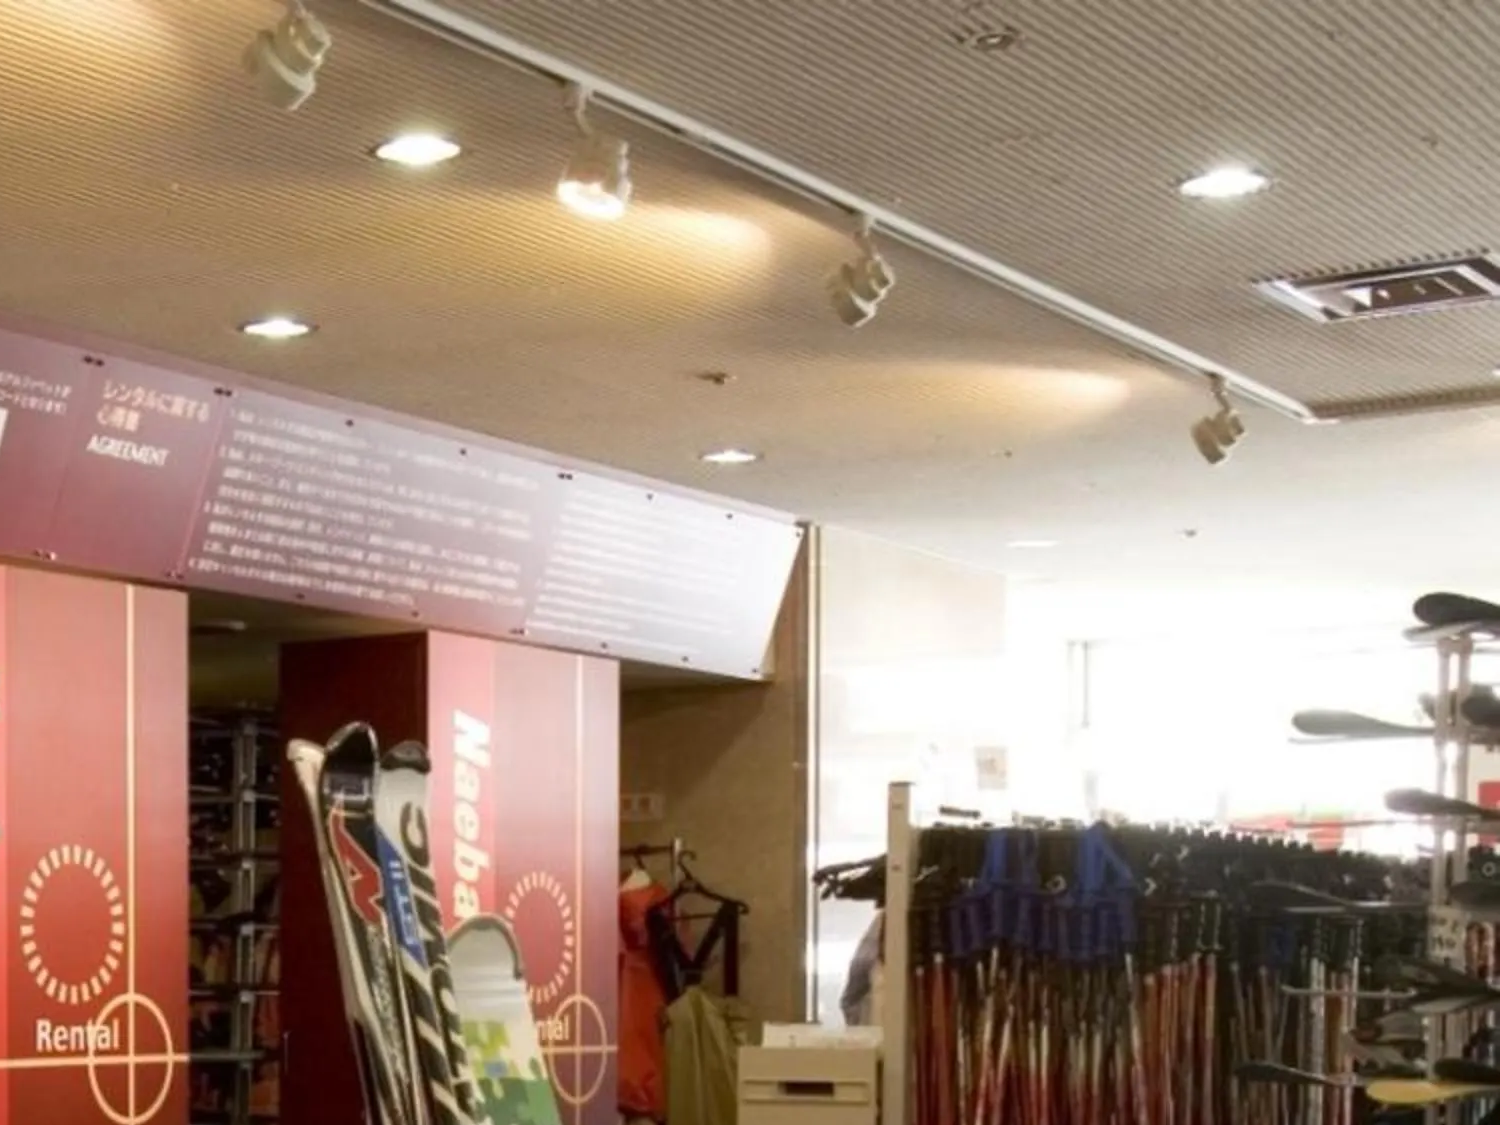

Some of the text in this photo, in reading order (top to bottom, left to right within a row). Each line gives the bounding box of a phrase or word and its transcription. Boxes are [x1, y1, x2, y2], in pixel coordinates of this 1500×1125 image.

[453, 709, 494, 919] Naeba
[36, 1018, 120, 1053] Rental
[536, 1015, 571, 1042] ntal
